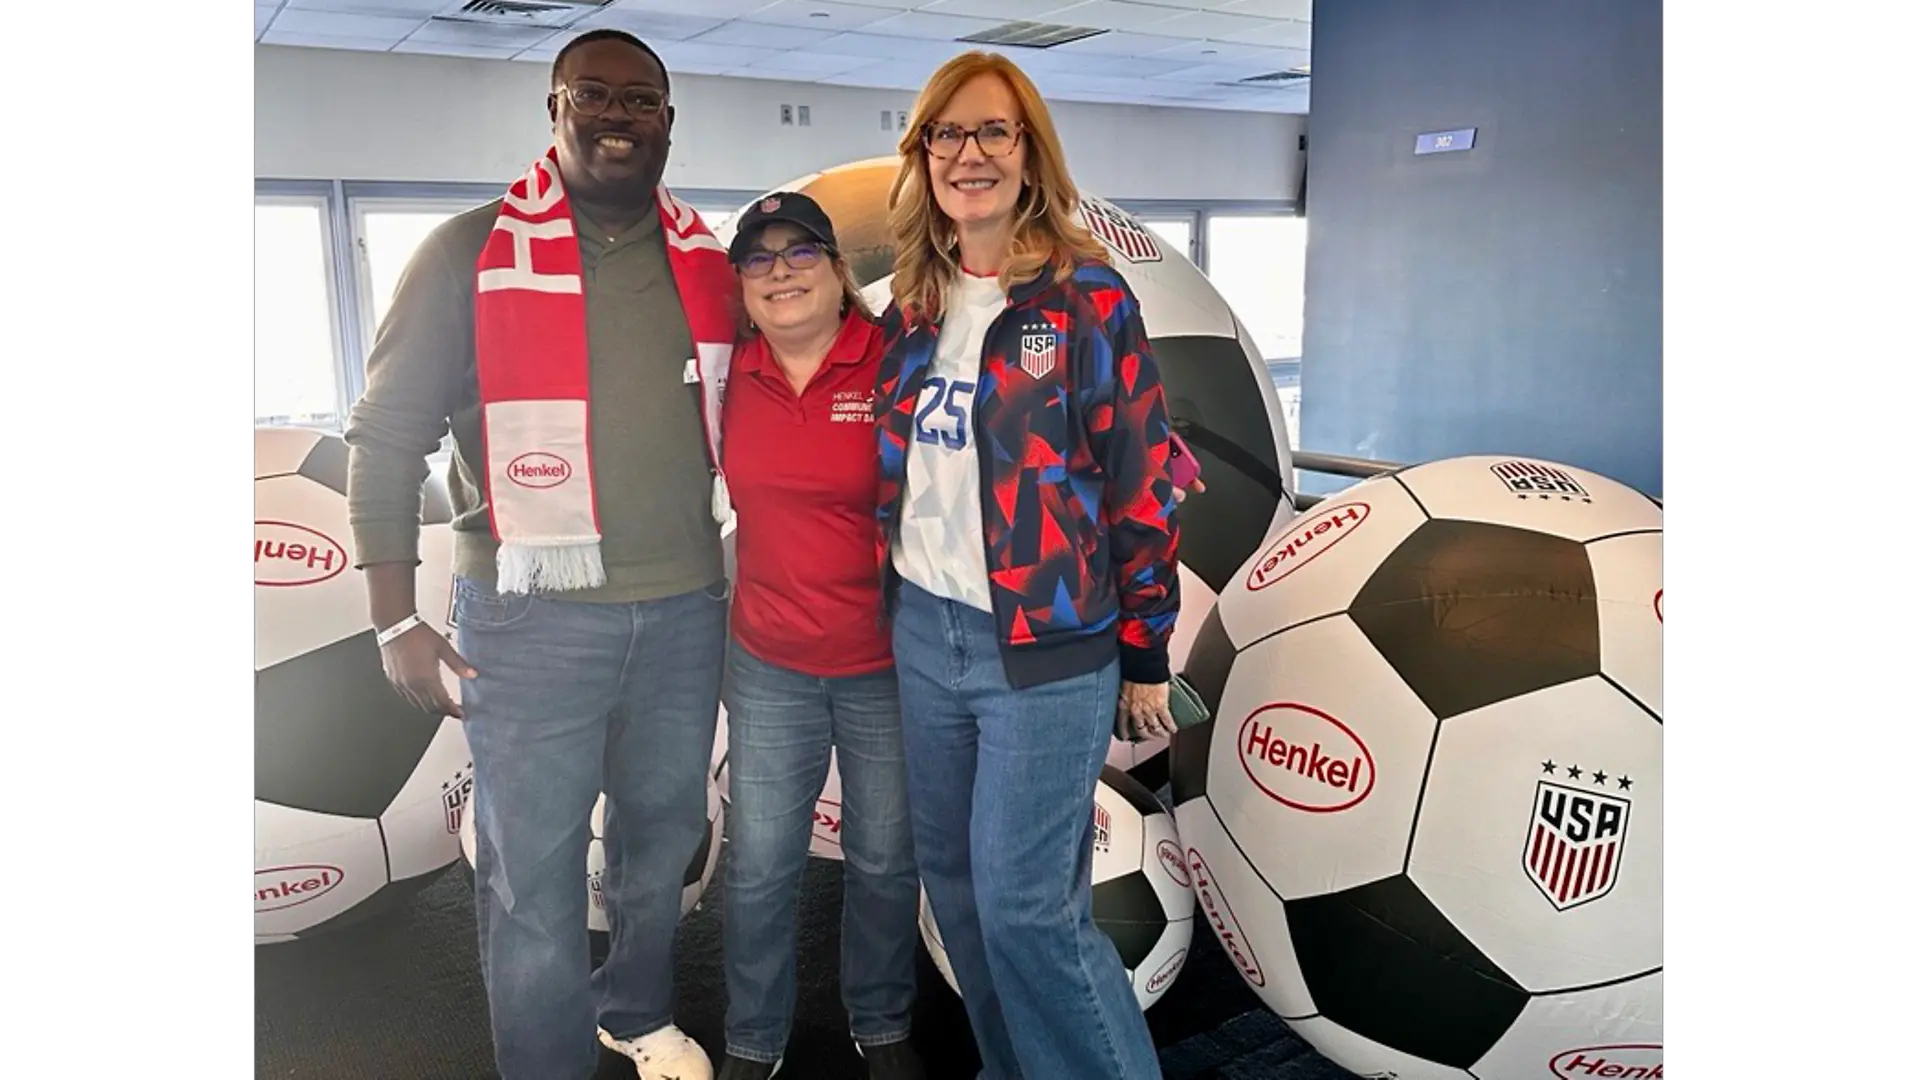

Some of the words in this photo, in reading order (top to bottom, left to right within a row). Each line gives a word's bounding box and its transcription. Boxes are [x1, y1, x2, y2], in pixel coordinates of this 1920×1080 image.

[1024, 336, 1054, 353] USA
[864, 413, 875, 423] DA
[916, 377, 975, 451] 25
[513, 463, 565, 477] Henkel
[1511, 476, 1579, 492] USA
[1255, 508, 1359, 583] Henkel
[1247, 721, 1361, 792] Henkel
[1541, 789, 1622, 843] USA
[254, 872, 330, 900] nkel
[1192, 862, 1257, 974] Henkel
